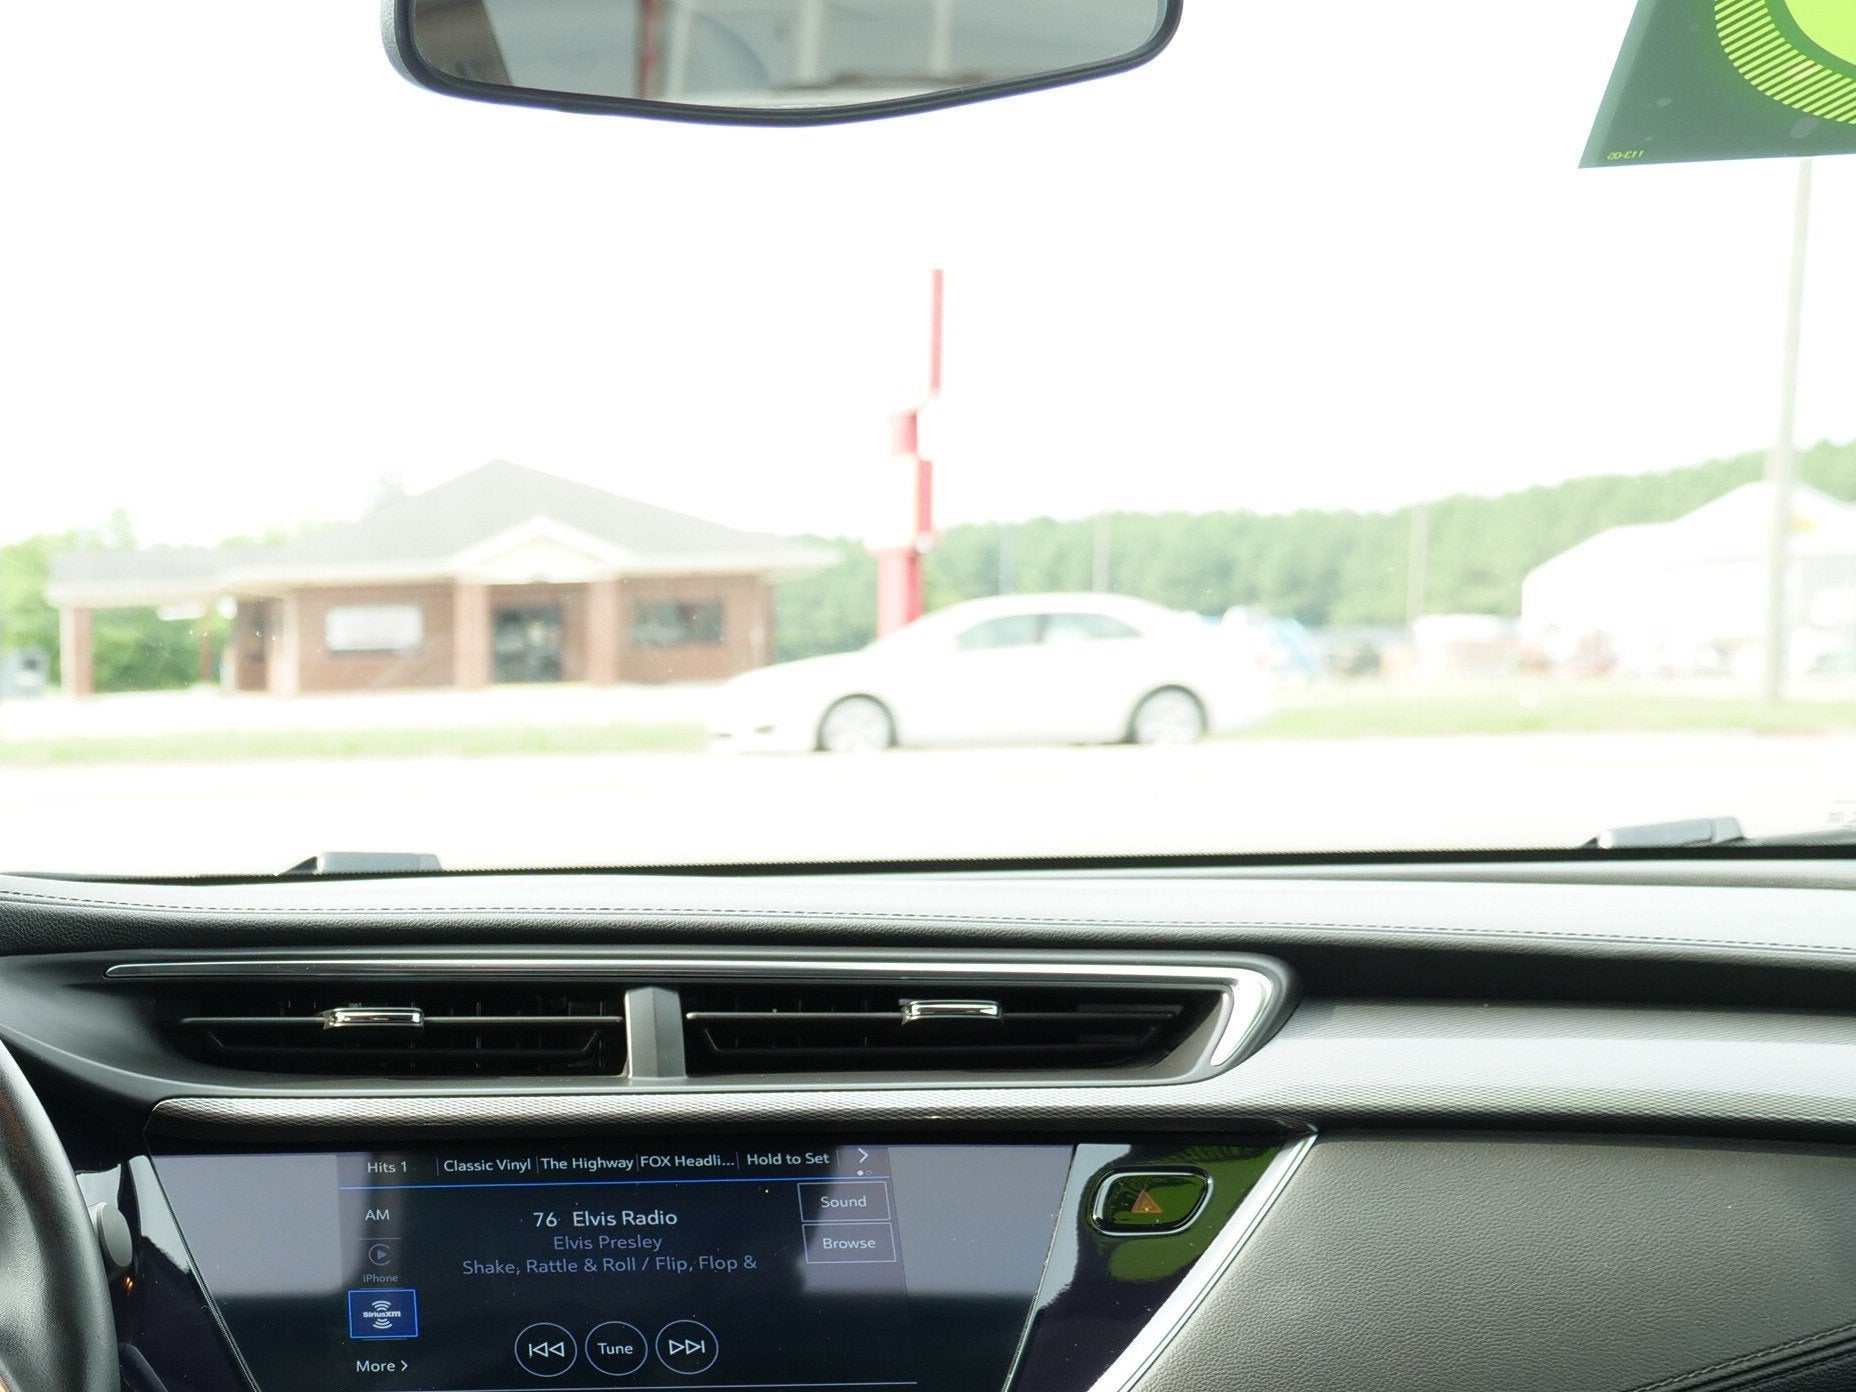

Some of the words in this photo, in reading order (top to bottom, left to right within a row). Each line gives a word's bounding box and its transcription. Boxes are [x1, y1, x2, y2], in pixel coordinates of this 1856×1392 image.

[540, 1158, 568, 1170] The
[572, 1156, 635, 1171] Highway
[640, 1155, 671, 1167] FOX
[675, 1154, 735, 1167] Headli...
[747, 1154, 782, 1165] Hold
[786, 1154, 801, 1165] to
[805, 1152, 830, 1165] Set
[366, 1161, 397, 1173] Hits
[400, 1161, 408, 1173] 1
[443, 1159, 494, 1172] Classic
[496, 1158, 532, 1173] Vinyl
[820, 1195, 867, 1208] Sound
[365, 1209, 390, 1221] AM
[533, 1212, 558, 1227] 76
[572, 1210, 617, 1227] Elvis
[622, 1210, 678, 1226] Radio
[553, 1236, 593, 1250] Elvis
[599, 1234, 662, 1253] Presley
[822, 1237, 876, 1250] Browse
[463, 1259, 521, 1275] Shake,
[526, 1259, 578, 1273] Rattle
[584, 1258, 597, 1272] &
[603, 1257, 636, 1271] Roll
[641, 1257, 650, 1272] /
[655, 1256, 693, 1274] Flip,
[698, 1255, 738, 1271] Flop
[743, 1255, 757, 1269] &
[362, 1273, 399, 1283] iPhone
[597, 1342, 634, 1355] Tune
[356, 1360, 396, 1372] More
